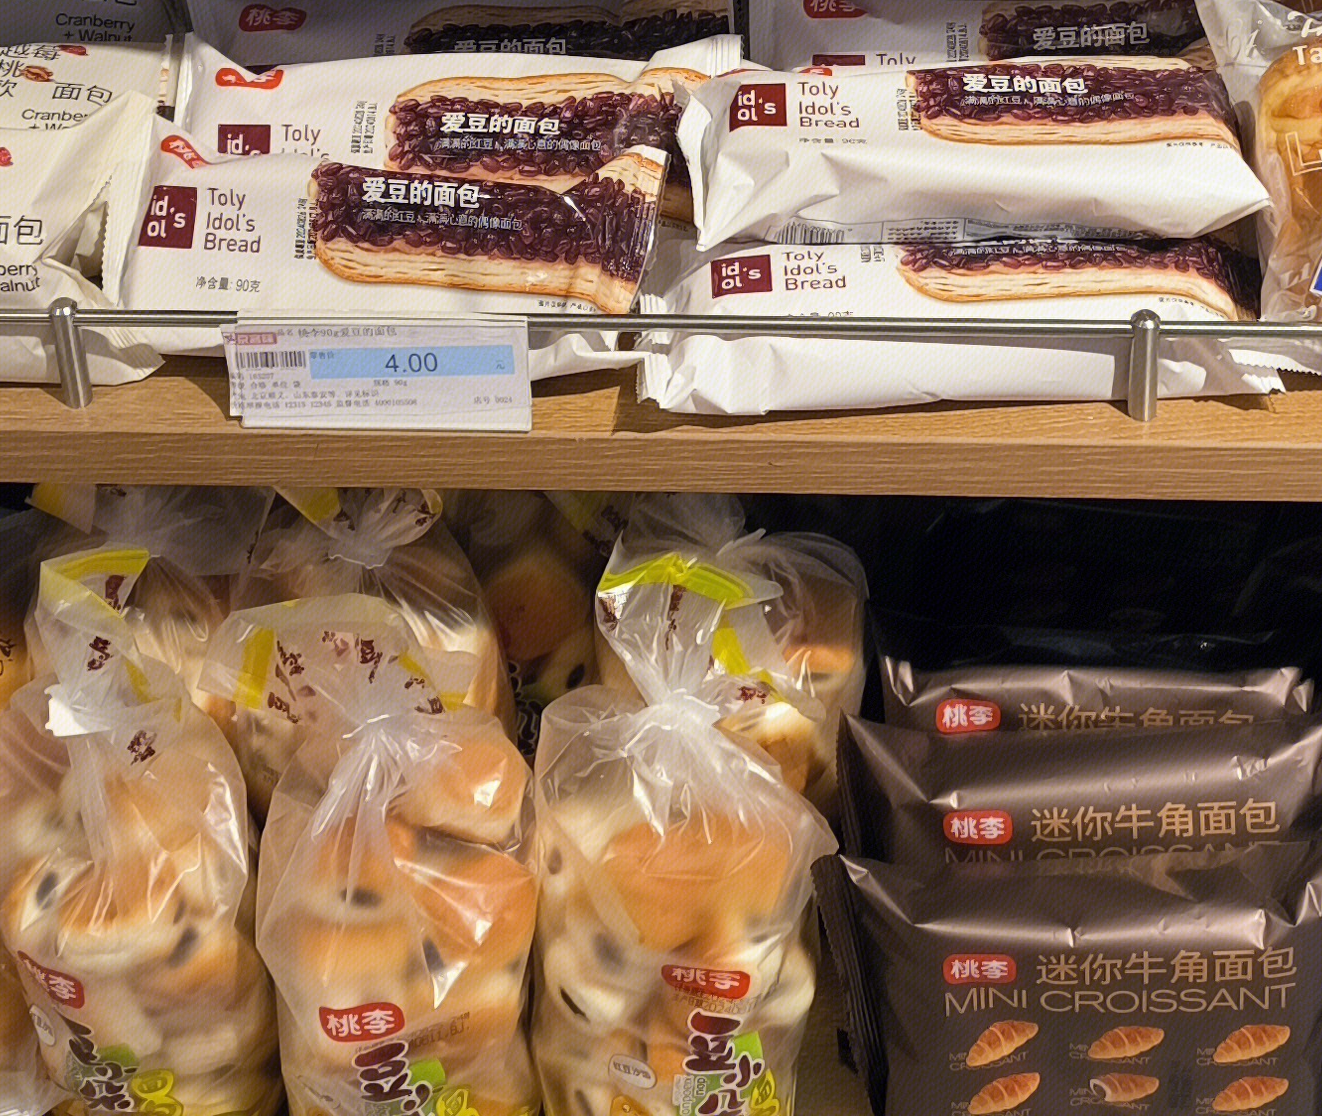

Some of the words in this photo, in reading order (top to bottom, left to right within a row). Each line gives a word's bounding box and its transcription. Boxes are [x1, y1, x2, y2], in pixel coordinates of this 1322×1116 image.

[54, 12, 136, 33] Cranberry
[244, 7, 300, 28] 桃李
[1032, 21, 1151, 50] 爱豆的面包
[51, 83, 114, 107] 面包
[798, 81, 840, 99] Toly
[961, 73, 1089, 95] 爱豆的面包
[798, 100, 853, 117] Idol's
[281, 123, 322, 146] Toly
[439, 111, 561, 136] 爱豆的面包
[798, 116, 860, 130] Bread
[206, 187, 247, 212] Toly
[361, 176, 481, 209] 爱豆的面包
[205, 211, 257, 234] Idol's
[203, 233, 262, 254] Bread
[781, 250, 825, 264] Toly
[783, 262, 838, 277] Idol's
[784, 275, 847, 291] Bread
[384, 352, 439, 373] 4.00
[942, 703, 994, 728] 桃李
[949, 814, 1006, 840] 桃李
[1030, 799, 1279, 843] 迷你牛角面包
[950, 959, 1009, 980] 桃李
[1035, 946, 1298, 986] 迷你牛角面包
[672, 967, 741, 990] 桃李
[945, 987, 1028, 1017] MINI
[1039, 982, 1297, 1013] CROISSANT
[326, 1010, 396, 1038] 桃李
